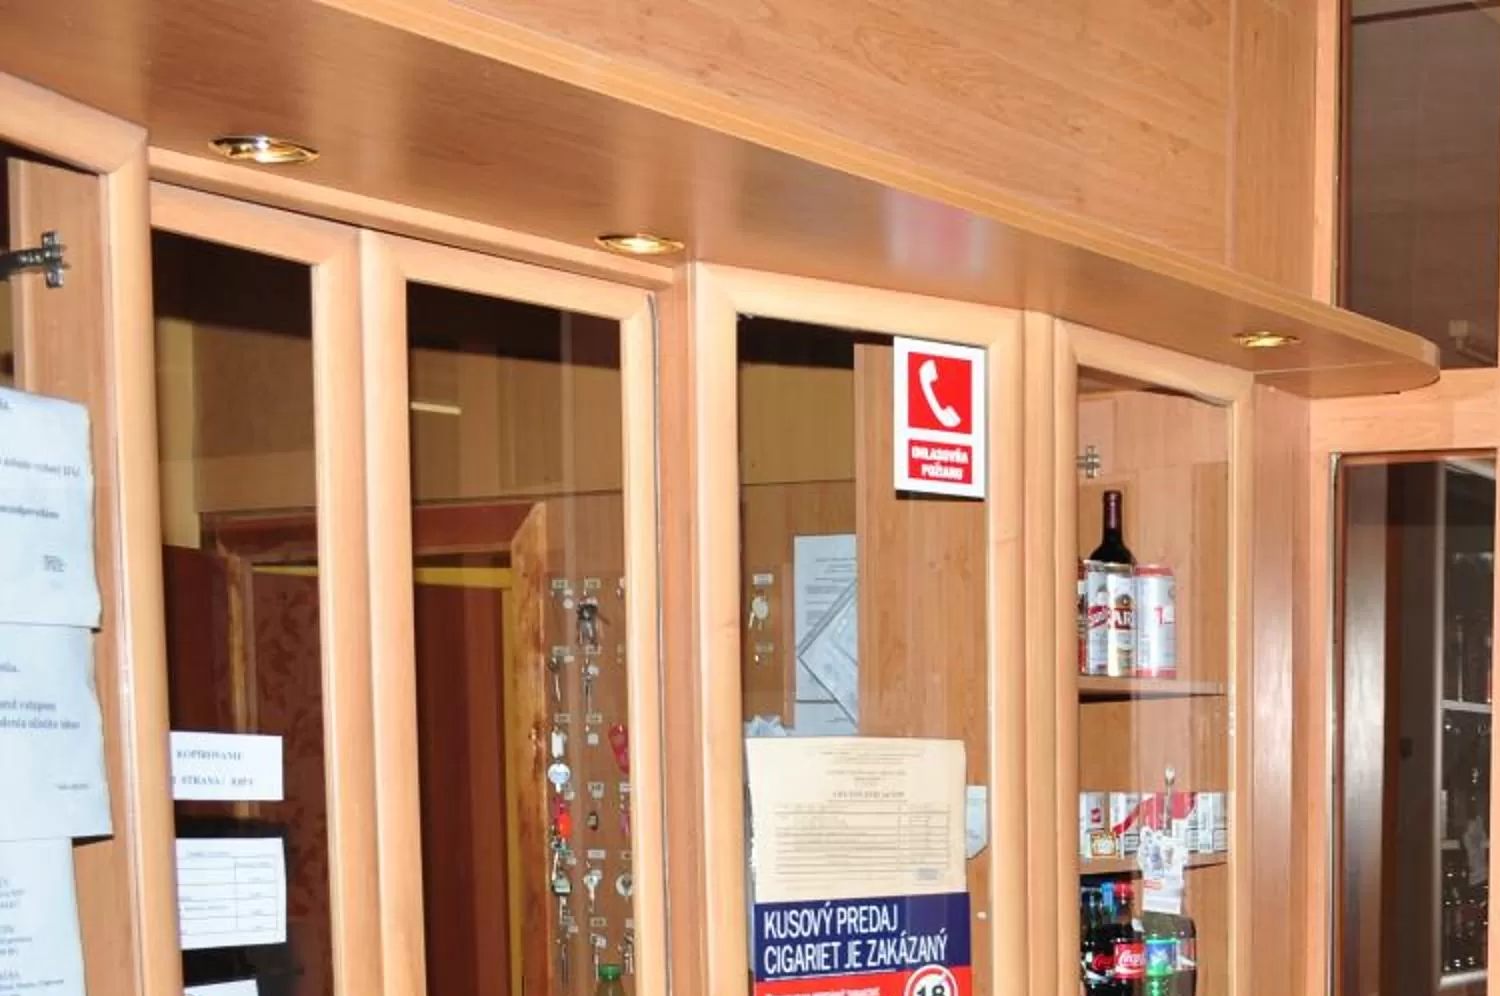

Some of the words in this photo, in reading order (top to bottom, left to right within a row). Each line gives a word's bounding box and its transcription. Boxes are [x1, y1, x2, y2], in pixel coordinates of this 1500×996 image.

[763, 901, 834, 940] KUSOVÝ
[836, 903, 899, 936] PREDAJ
[763, 941, 842, 975] CIGARIET
[844, 940, 864, 970] JE
[866, 927, 949, 968] ZAKÁZANÝ
